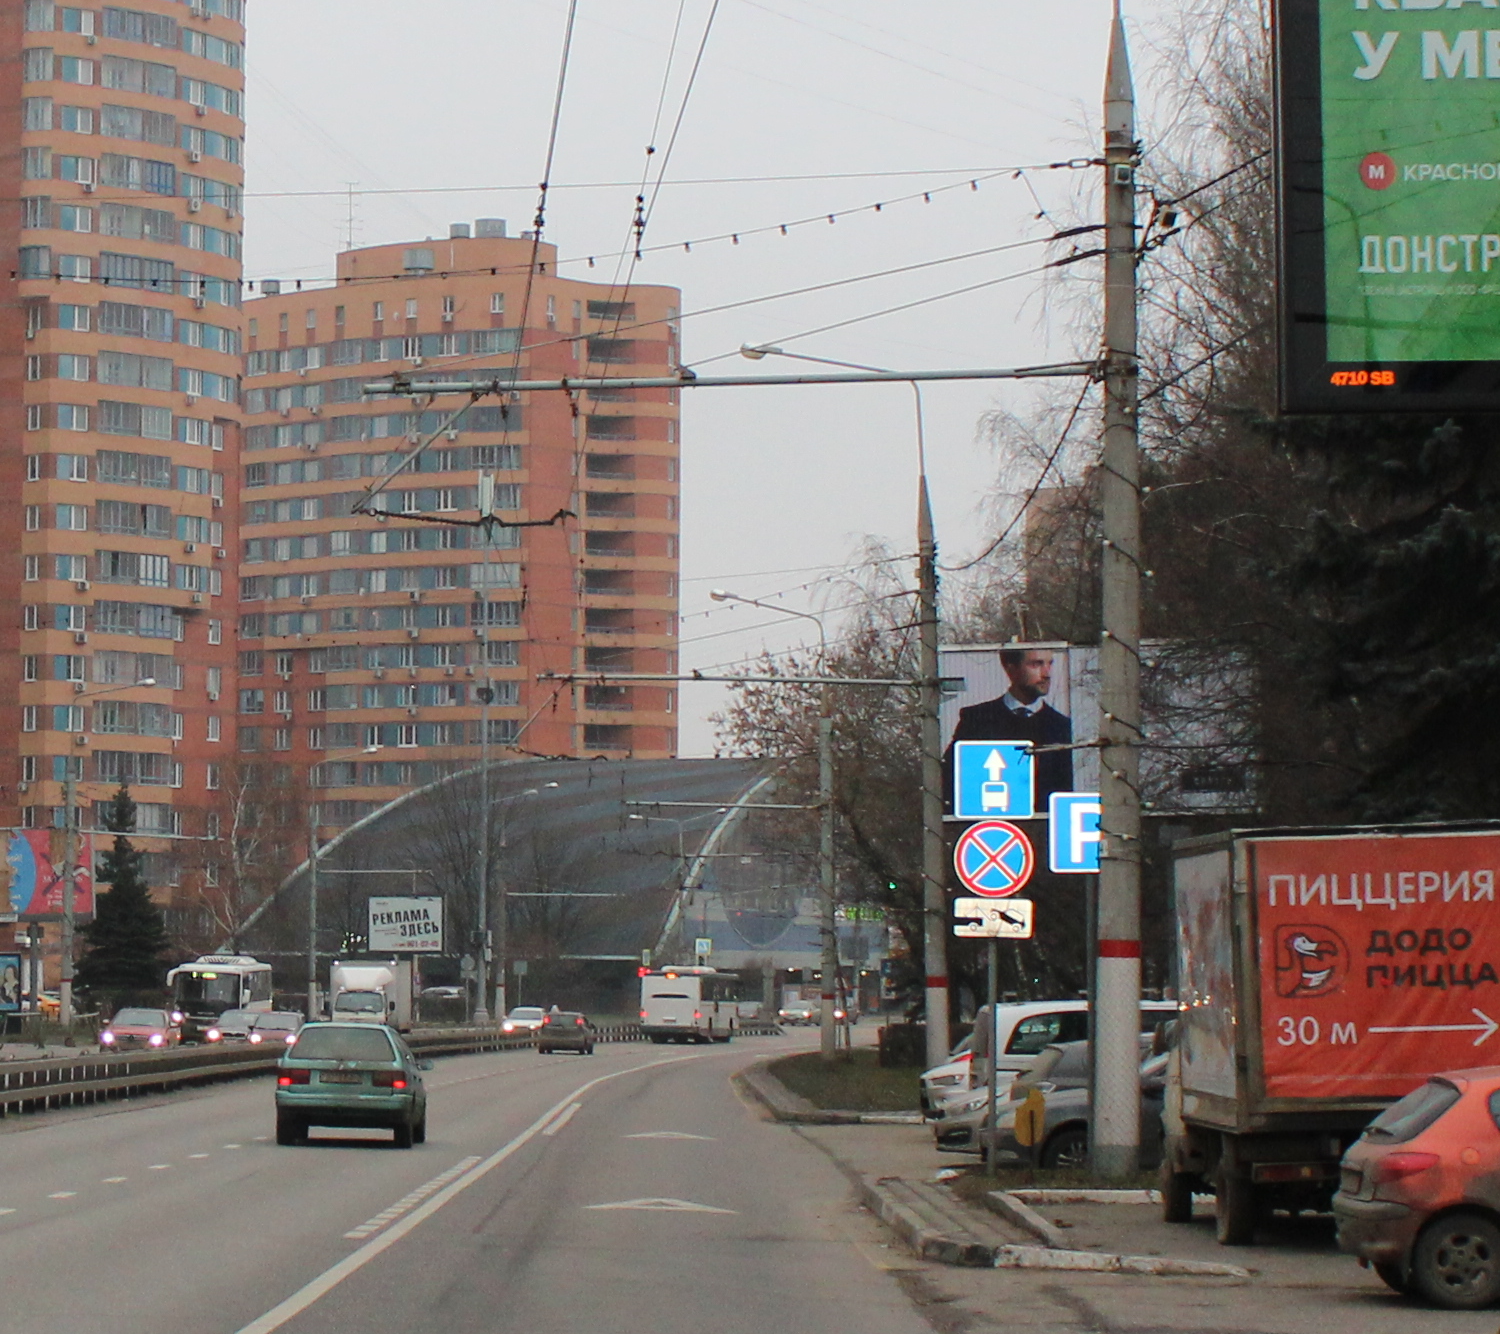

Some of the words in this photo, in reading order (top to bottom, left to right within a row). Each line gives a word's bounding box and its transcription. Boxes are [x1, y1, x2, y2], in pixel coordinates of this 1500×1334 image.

[1352, 30, 1399, 81] У
[1070, 802, 1101, 863] P
[1268, 870, 1495, 912] ПИЦЦЕРИЯ
[372, 908, 430, 926] РЕКЛАМА
[400, 922, 439, 937] ЗДЕСЬ
[1366, 928, 1473, 957] ДОДО
[1366, 963, 1500, 990] ПИЦЦА
[1277, 1016, 1320, 1046] 30
